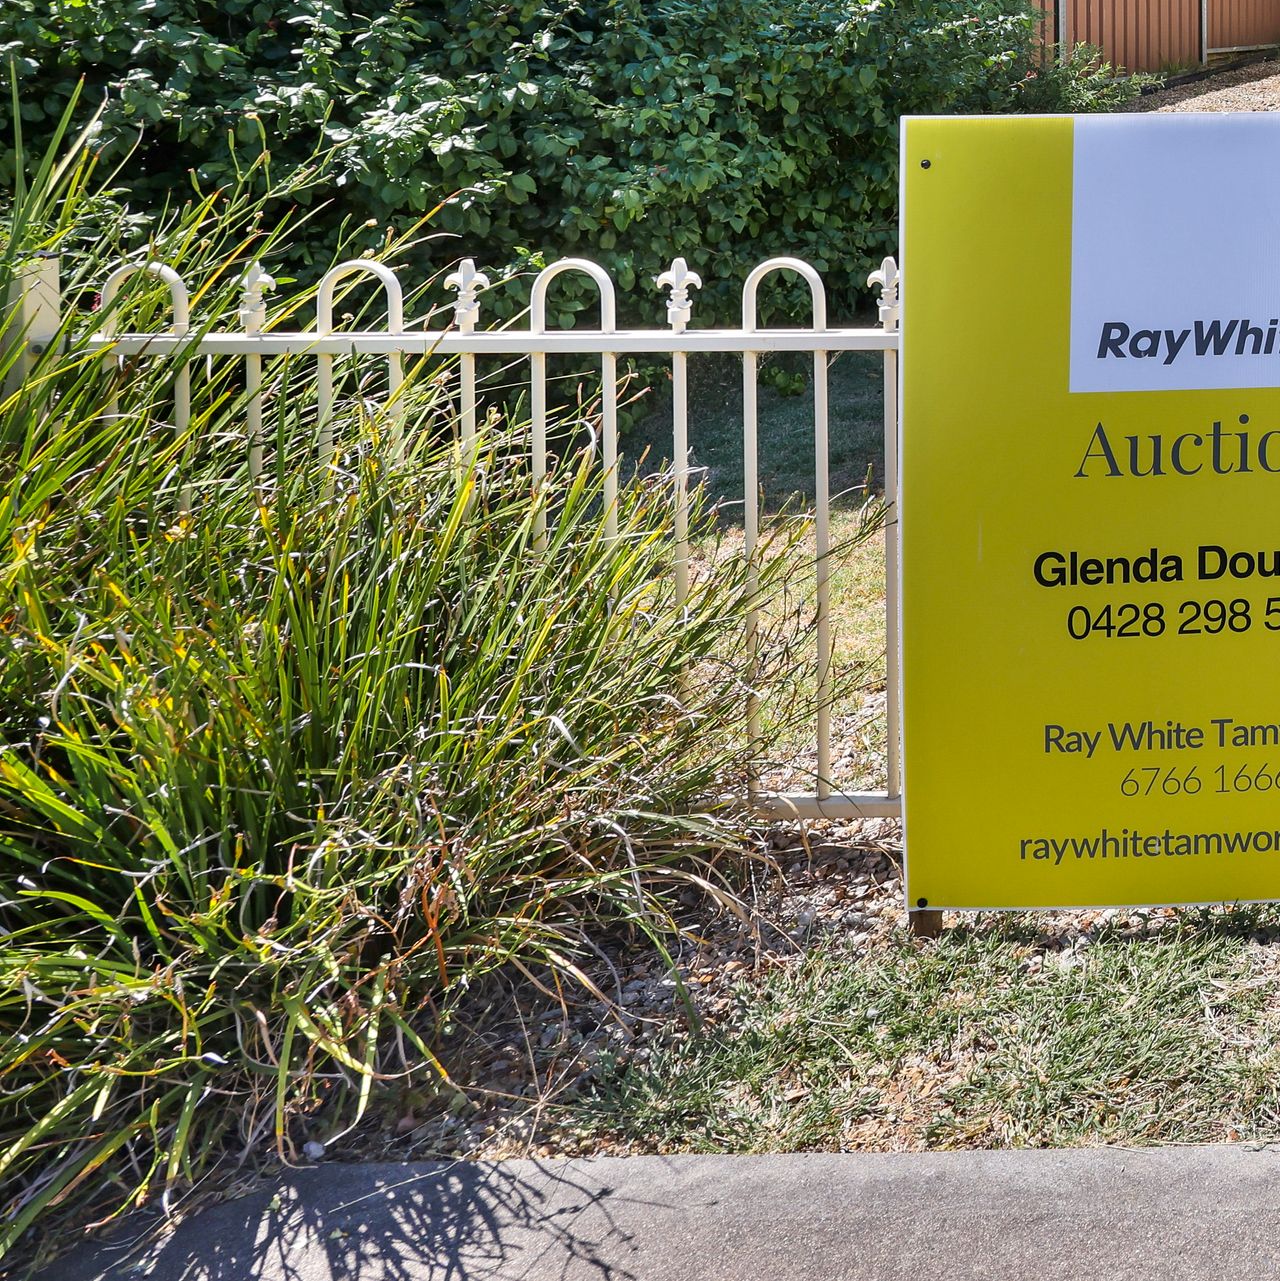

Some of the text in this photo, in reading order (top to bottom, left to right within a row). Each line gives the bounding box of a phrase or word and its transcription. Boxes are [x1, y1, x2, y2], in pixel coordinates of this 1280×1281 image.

[1033, 548, 1185, 588] Glenda
[1067, 602, 1166, 640] 0428
[1177, 599, 1252, 635] 298
[1044, 724, 1102, 759] Ray
[1107, 720, 1204, 752] White
[1120, 765, 1202, 797] 6766
